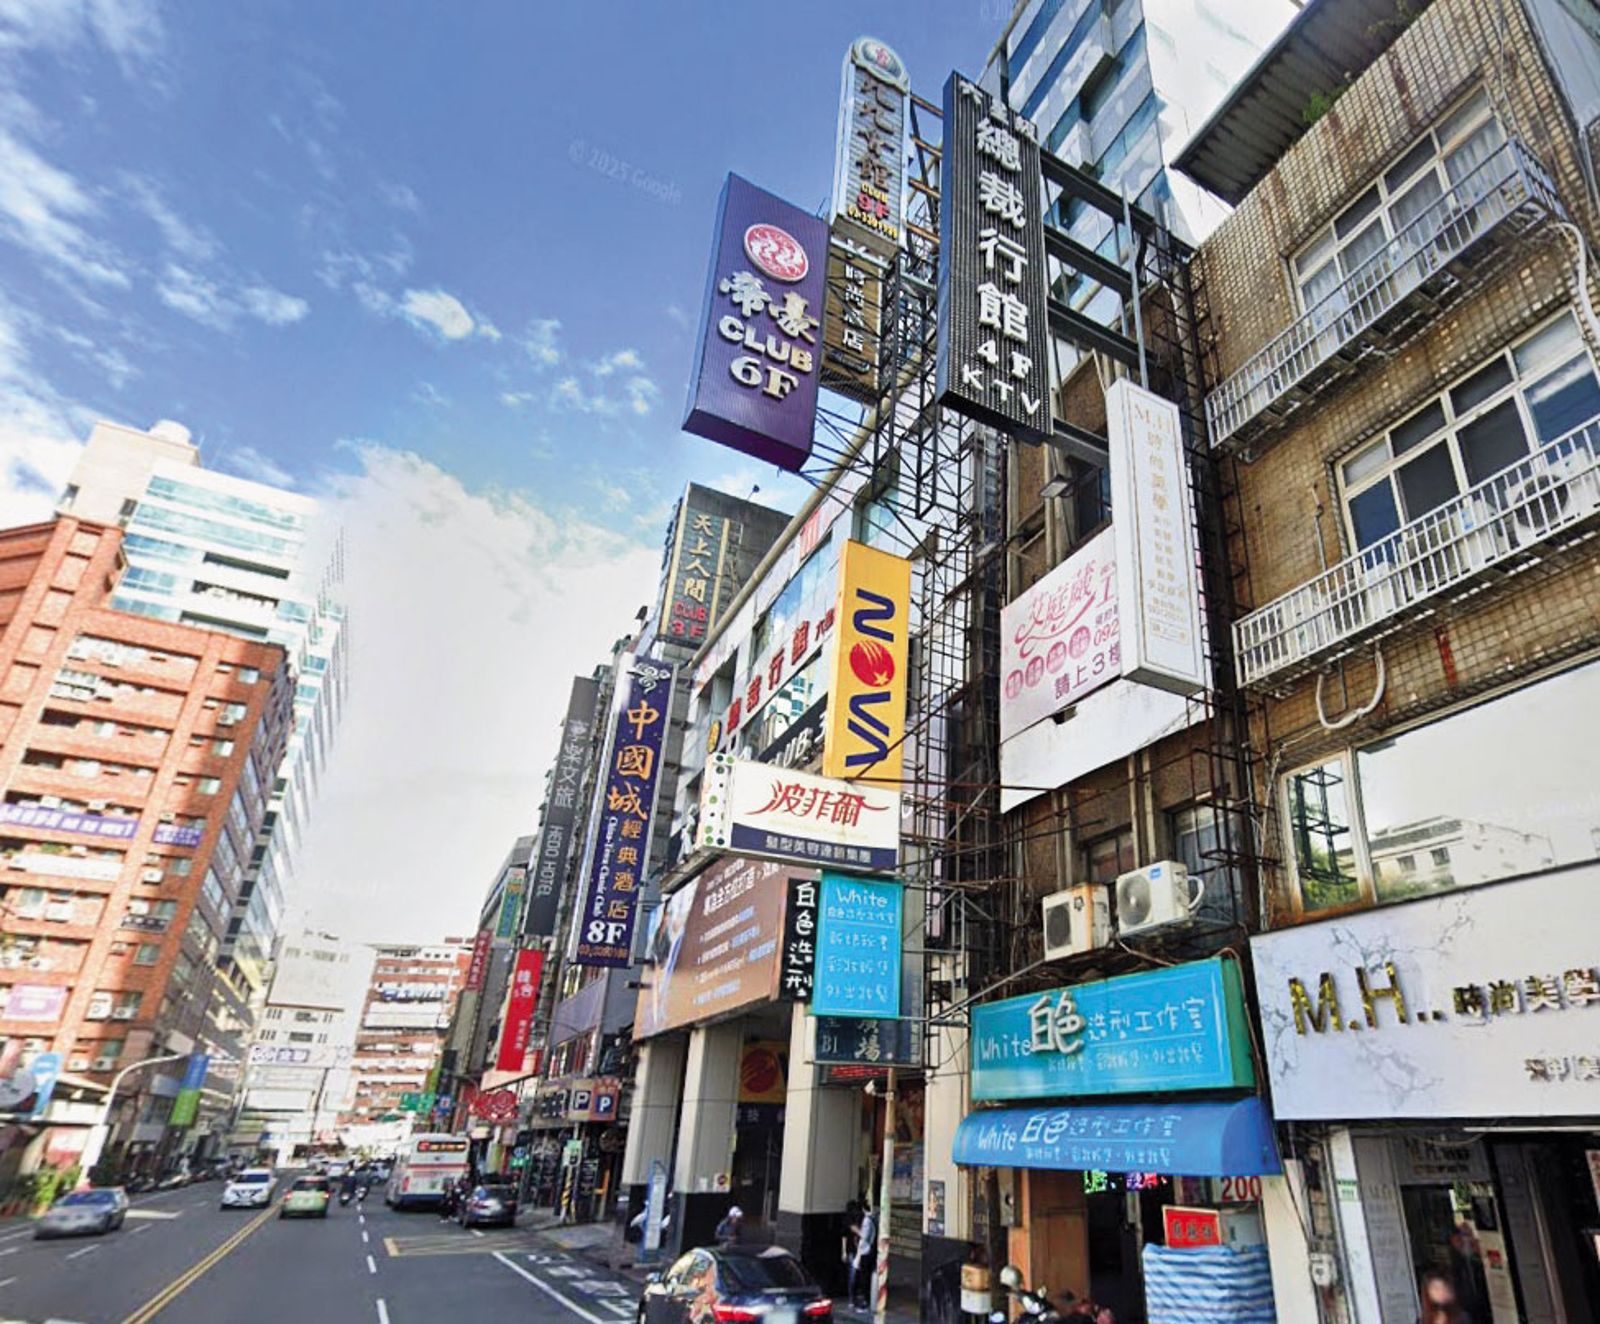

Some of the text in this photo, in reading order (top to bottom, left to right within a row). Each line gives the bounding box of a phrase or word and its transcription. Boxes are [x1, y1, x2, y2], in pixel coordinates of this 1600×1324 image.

[976, 118, 1030, 344] 總裁行館
[719, 271, 819, 345] 帝豪
[718, 315, 813, 374] CLUB
[976, 338, 1033, 380] 4F
[730, 355, 800, 401] 6F
[962, 363, 1040, 415] KTV
[684, 514, 714, 603] 天上人間
[671, 619, 705, 639] 3F
[672, 603, 708, 622] CLUB
[607, 699, 661, 821] 中國城
[606, 817, 644, 921] 經典酒店
[836, 886, 888, 909] White
[586, 919, 627, 945] 8F
[785, 881, 815, 998] 白色造型
[979, 1040, 1031, 1062] White
[1027, 990, 1086, 1055] 白色
[1088, 998, 1205, 1041] 造型工作室
[574, 1090, 590, 1110] P
[599, 1096, 612, 1112] P
[978, 1126, 1017, 1152] White
[1020, 1111, 1070, 1144] 白色
[1220, 1176, 1263, 1203] 200
